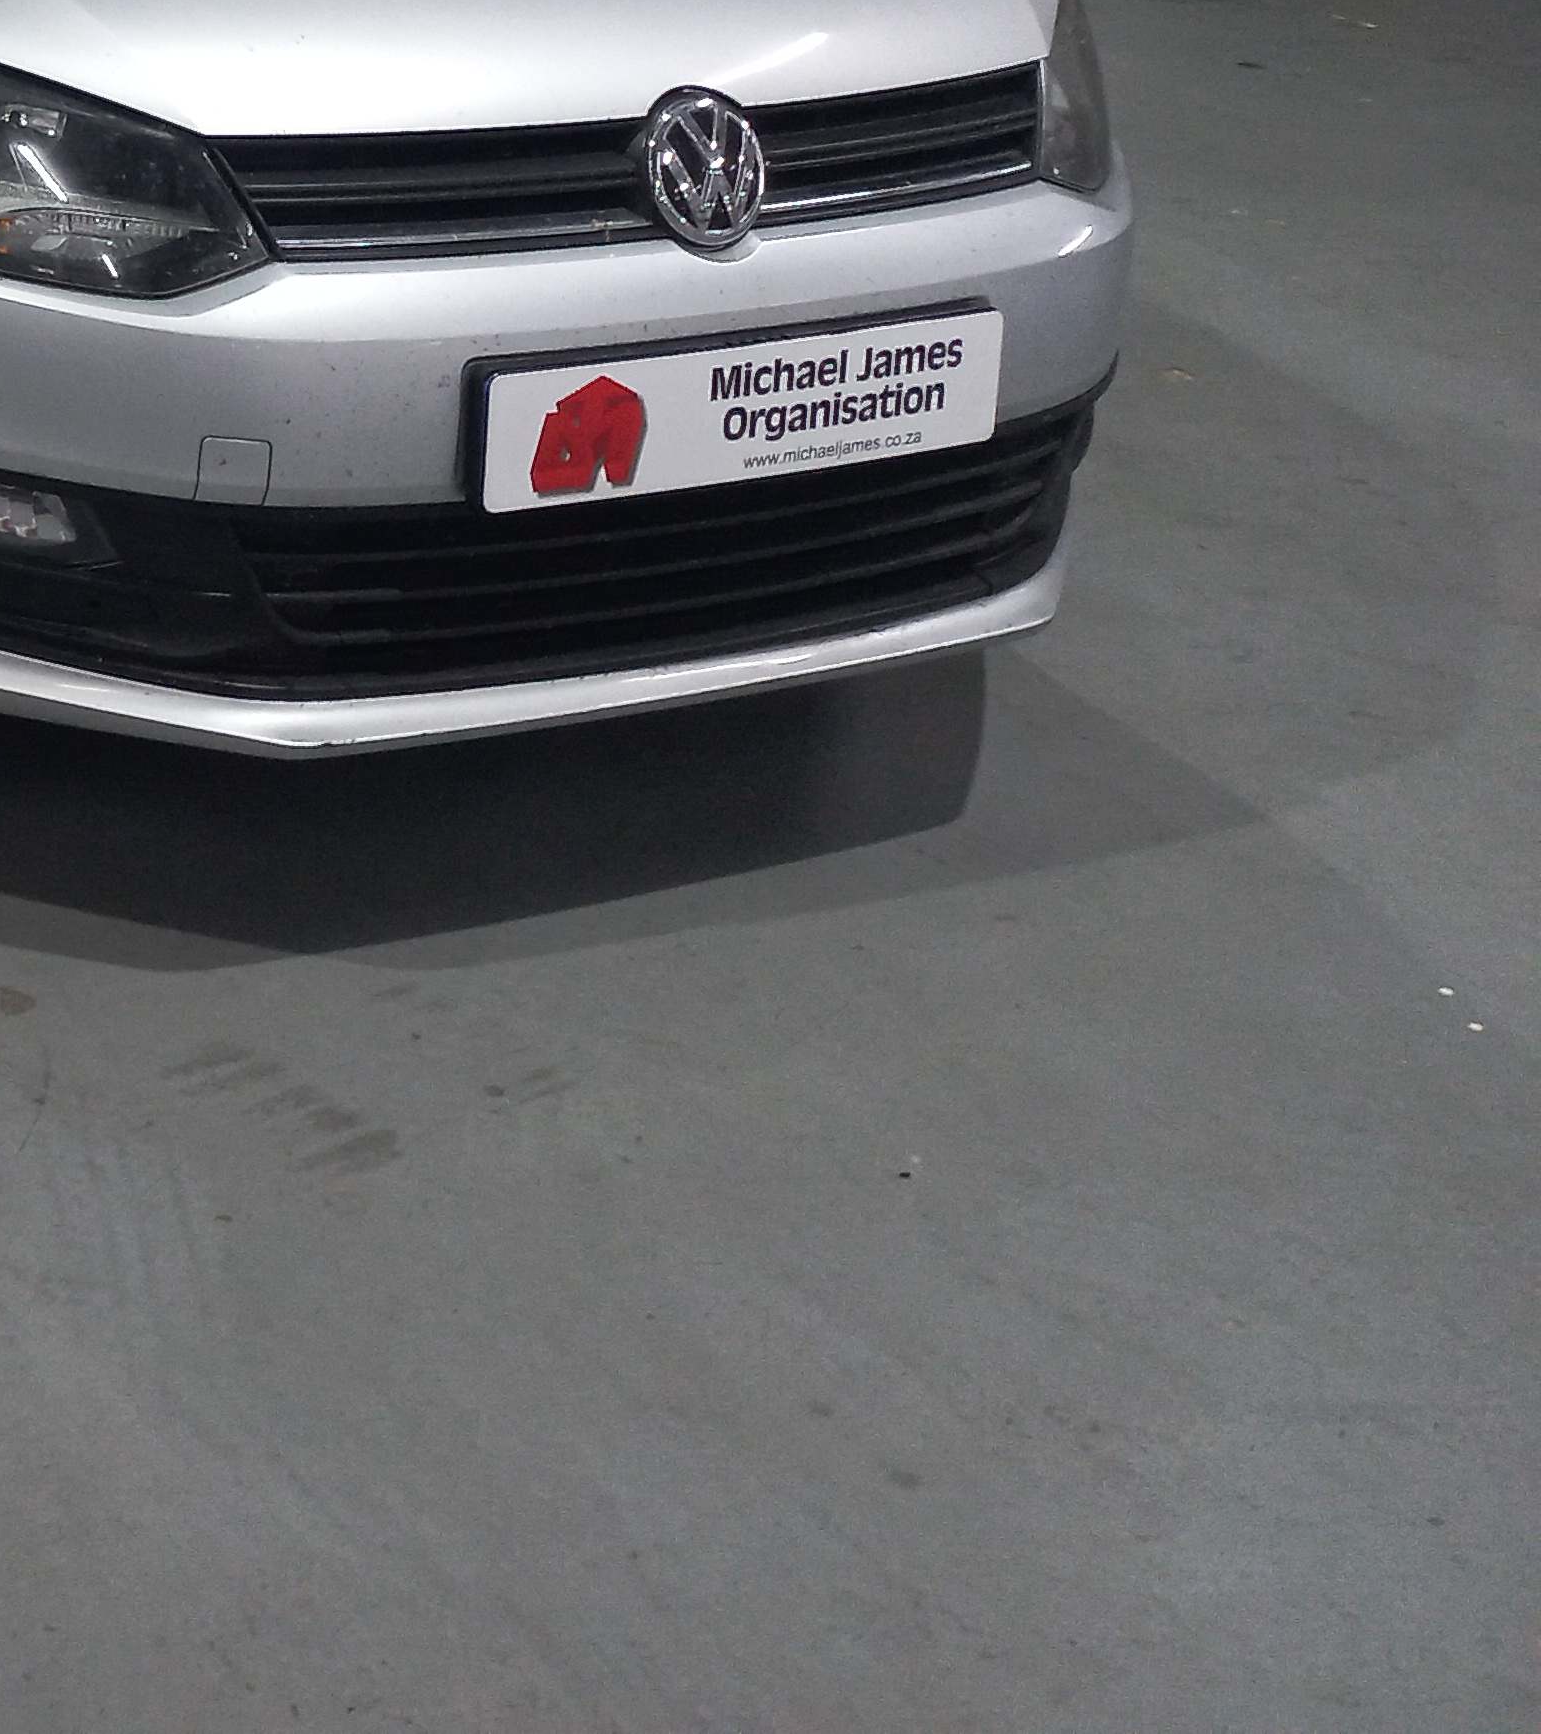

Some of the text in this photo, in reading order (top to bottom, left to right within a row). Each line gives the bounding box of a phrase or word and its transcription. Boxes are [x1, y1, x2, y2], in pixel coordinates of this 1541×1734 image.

[710, 338, 964, 402] Michael James
[723, 382, 945, 441] Organisation
